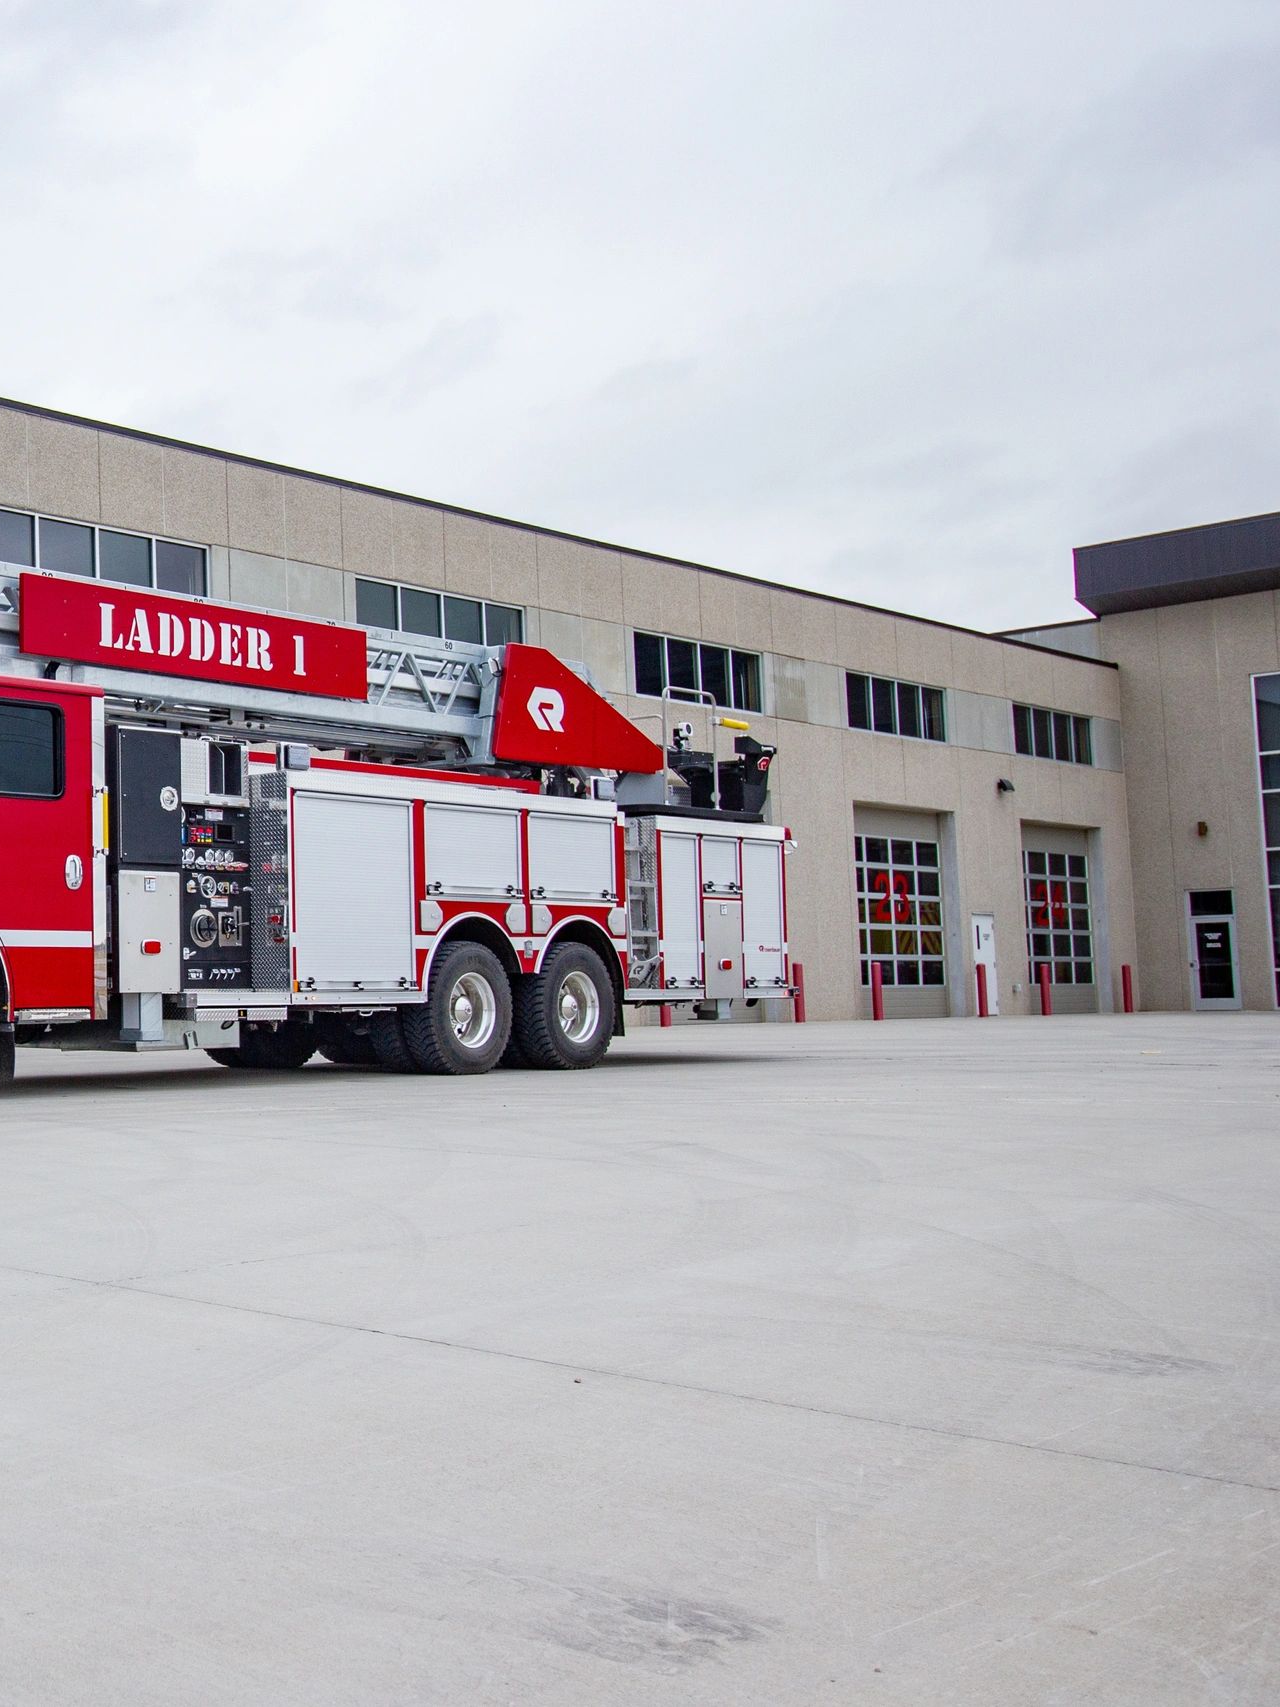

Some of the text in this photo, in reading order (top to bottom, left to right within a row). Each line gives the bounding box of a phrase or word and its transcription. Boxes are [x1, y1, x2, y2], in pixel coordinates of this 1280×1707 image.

[98, 602, 307, 676] LADDER 1
[444, 641, 453, 650] 60
[874, 871, 911, 922] 23
[1035, 882, 1066, 928] 24
